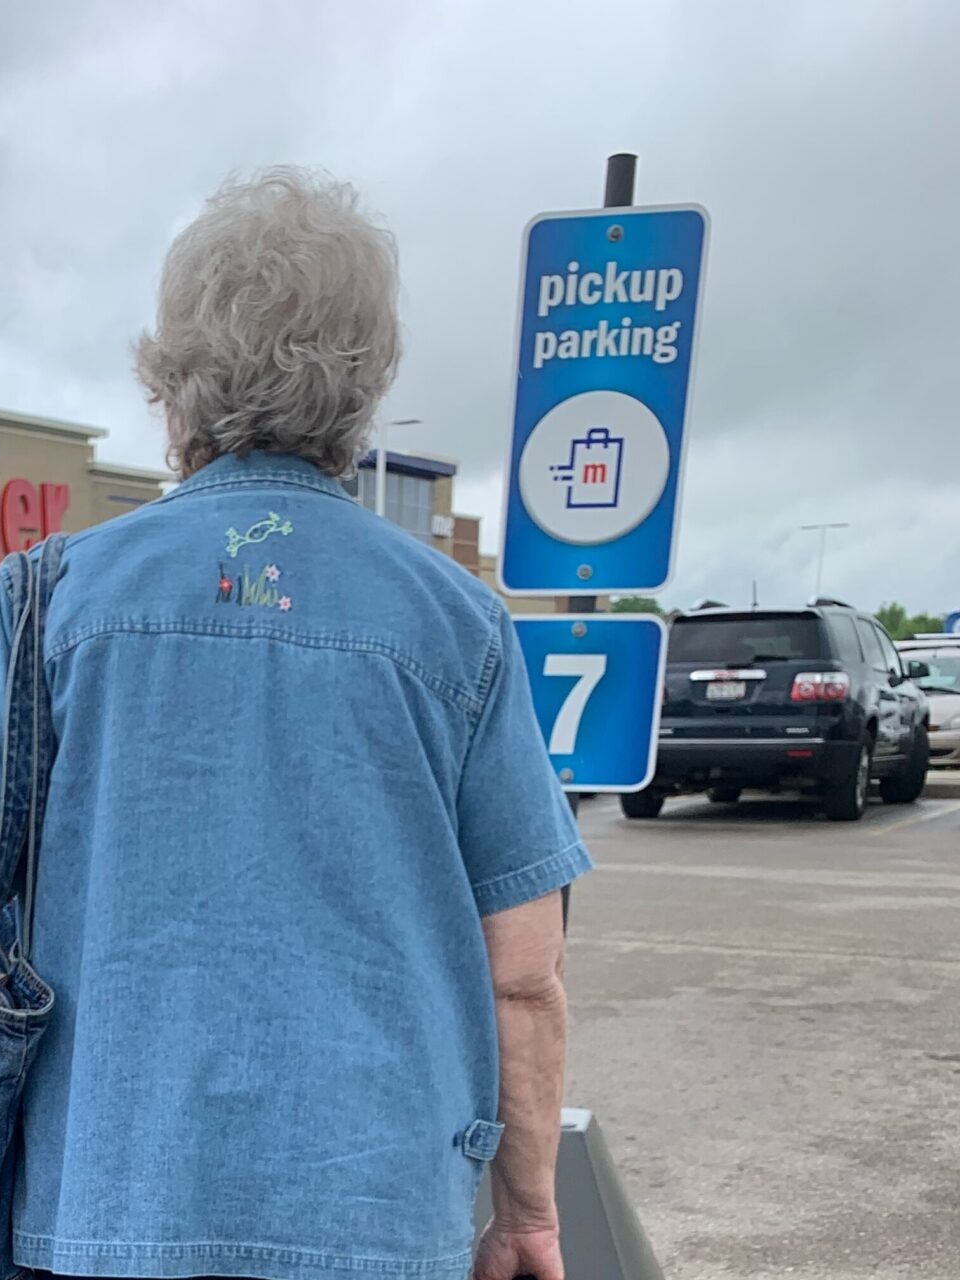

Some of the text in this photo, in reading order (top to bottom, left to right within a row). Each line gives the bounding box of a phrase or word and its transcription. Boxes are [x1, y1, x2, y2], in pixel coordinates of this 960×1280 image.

[537, 261, 684, 317] pickup
[533, 317, 682, 369] parking
[582, 463, 607, 484] m
[542, 653, 608, 755] 7
